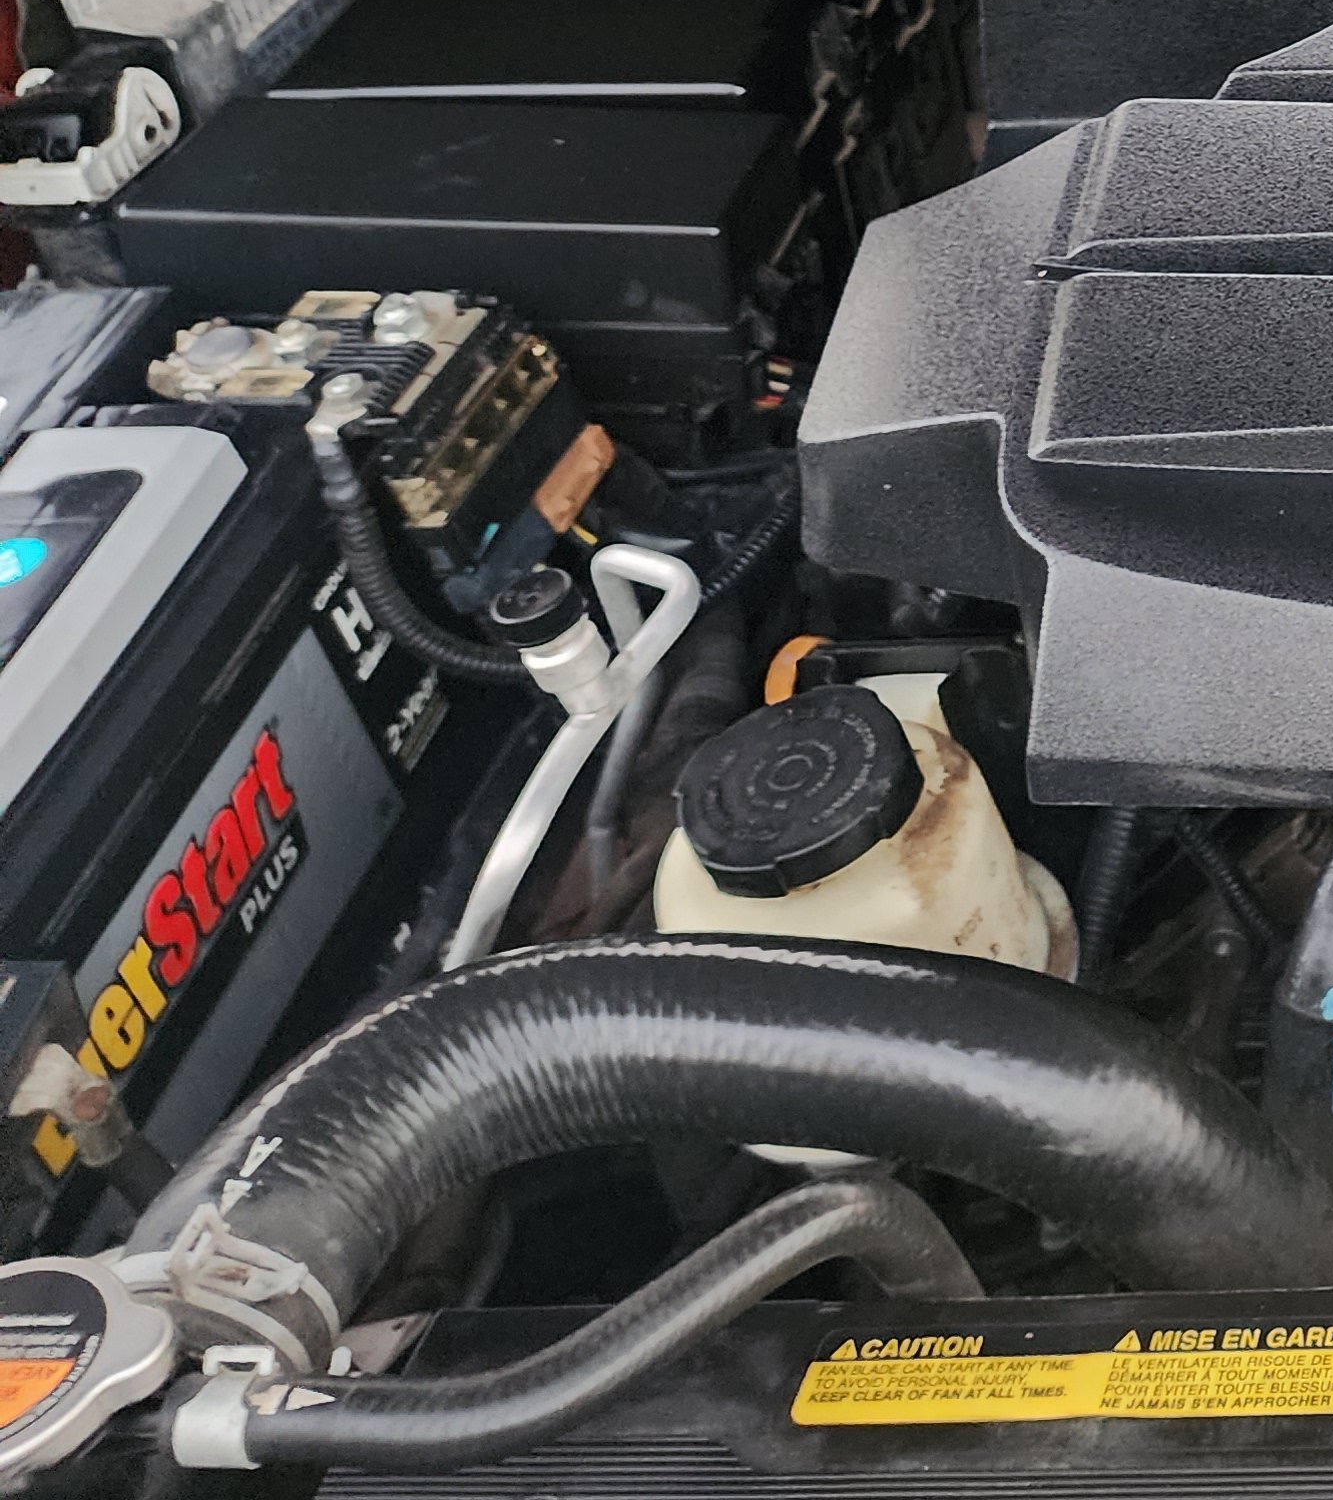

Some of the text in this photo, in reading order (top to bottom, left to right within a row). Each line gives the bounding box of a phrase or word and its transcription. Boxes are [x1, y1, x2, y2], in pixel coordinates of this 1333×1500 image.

[238, 834, 299, 933] PLUS
[860, 1335, 984, 1360] CAUTION
[1149, 1329, 1217, 1352] MISE
[1221, 1328, 1262, 1350] EN
[819, 1365, 848, 1376] FAN
[851, 1364, 900, 1376] BLADE
[903, 1363, 935, 1374] CAN
[937, 1361, 983, 1373] START
[984, 1361, 1004, 1372] AT
[1005, 1360, 1037, 1371] ANY
[1112, 1354, 1333, 1370] LE VENTILATEUR RISQUE DE
[816, 1378, 835, 1389] TO
[837, 1377, 884, 1389] AVOID
[886, 1375, 968, 1388] PERSONAL
[1218, 1369, 1259, 1381] TOUT
[808, 1391, 850, 1403] KEEP
[853, 1389, 905, 1402] CLEAR
[908, 1389, 930, 1400] OF
[932, 1388, 962, 1400] FAN
[964, 1388, 985, 1399] AT
[987, 1387, 1016, 1399] ALL
[1103, 1384, 1149, 1396] POUR
[1215, 1382, 1266, 1395] TOUTE
[1099, 1398, 1123, 1409] NE
[1126, 1397, 1186, 1410] JAMAIS
[1230, 1395, 1332, 1409] APPROCHER
